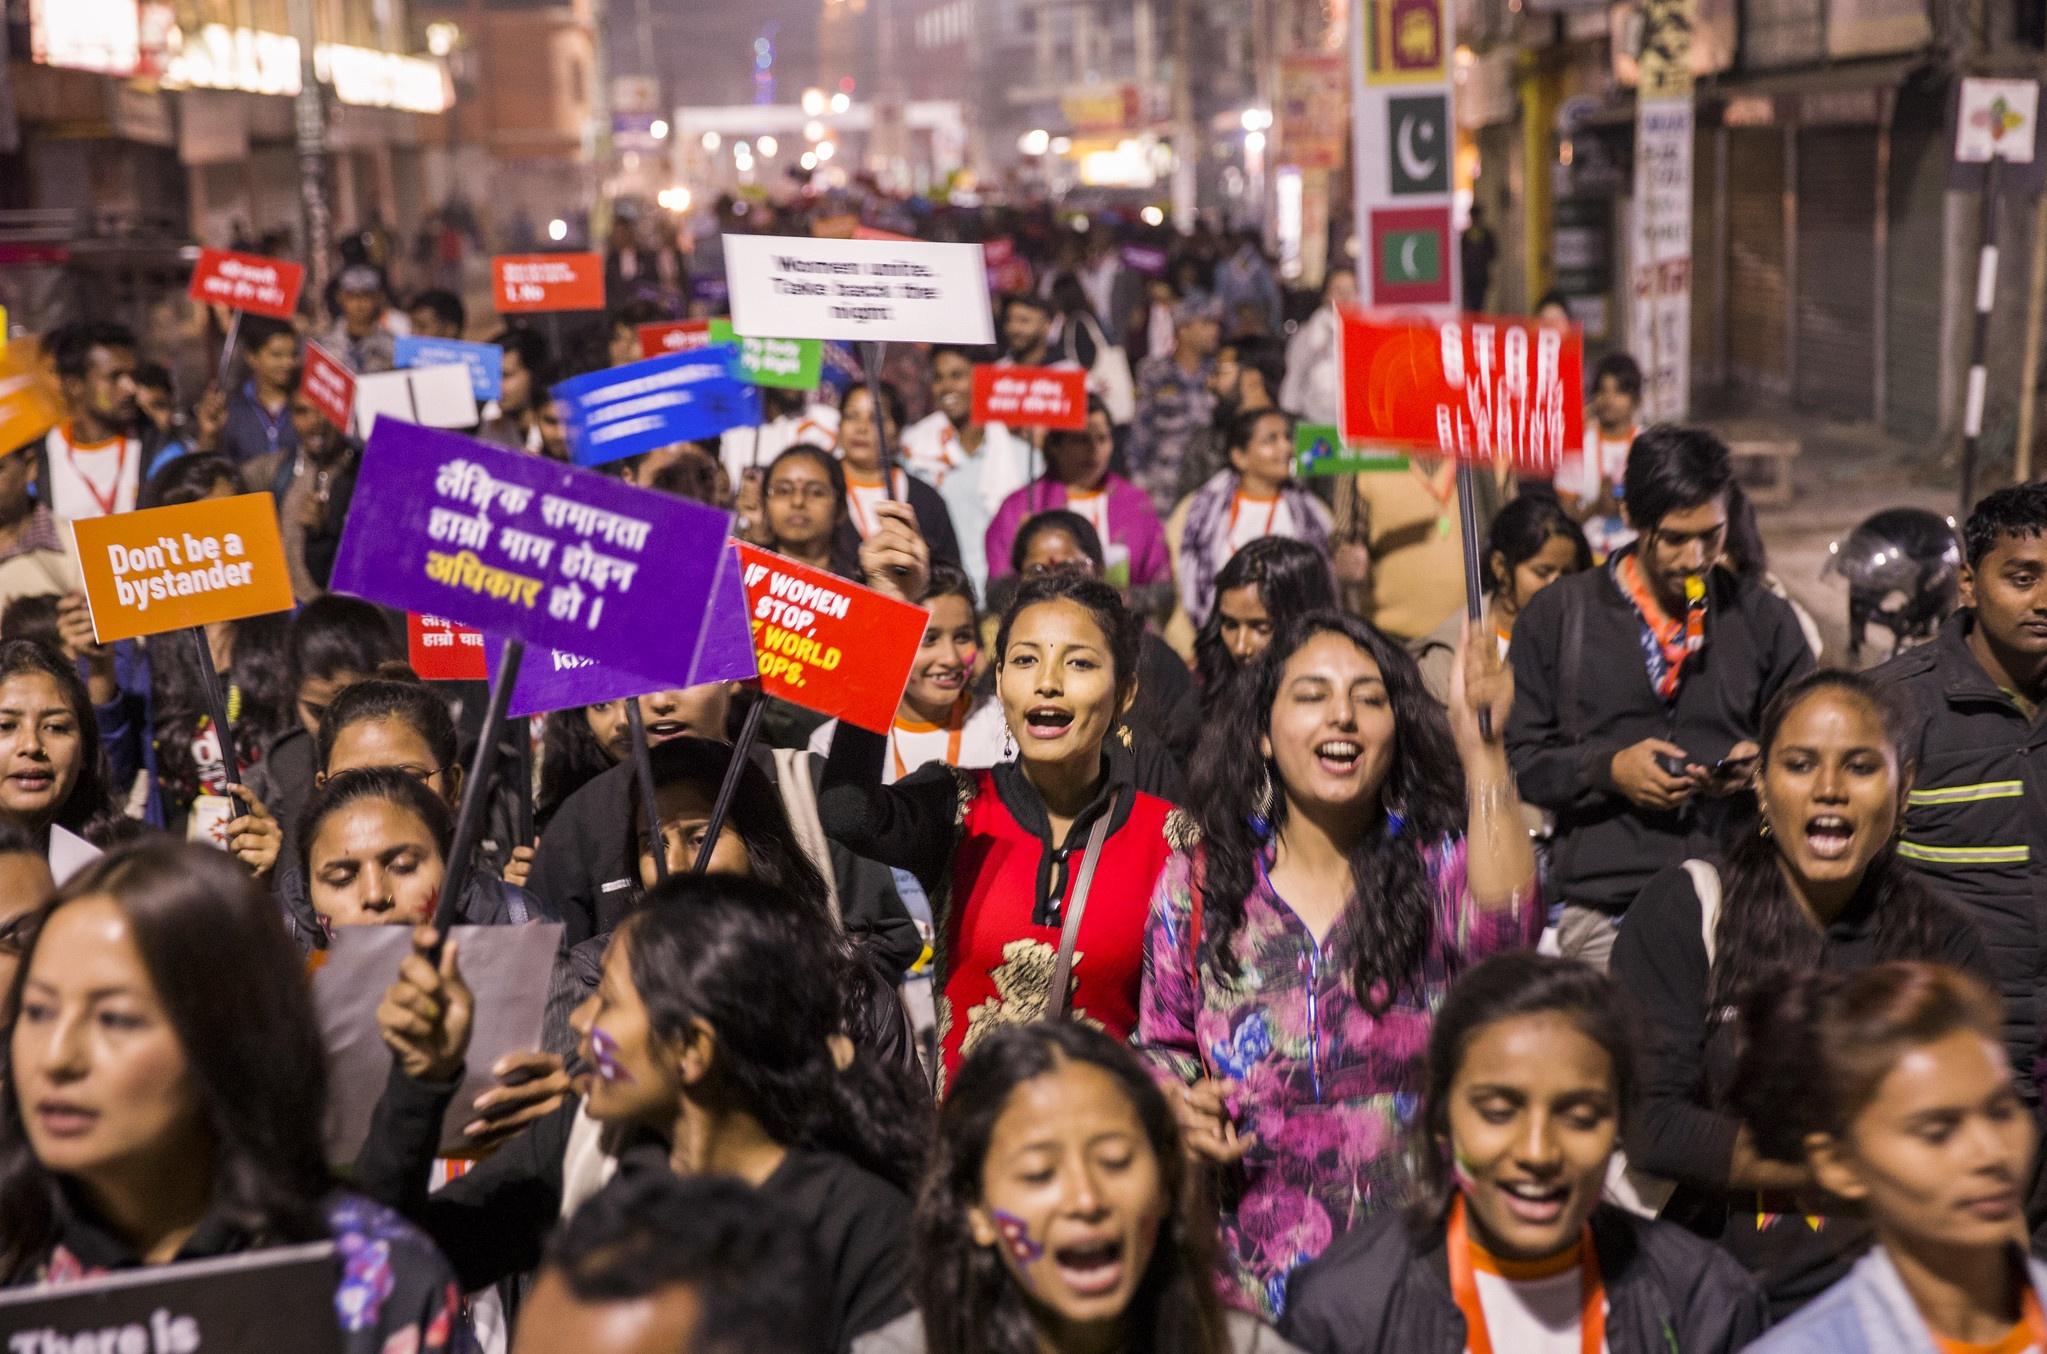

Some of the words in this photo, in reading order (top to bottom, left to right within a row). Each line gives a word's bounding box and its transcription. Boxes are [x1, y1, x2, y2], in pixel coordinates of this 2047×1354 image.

[769, 276, 828, 297] Take
[834, 281, 894, 299] back
[897, 284, 944, 300] the
[770, 255, 858, 277] Women
[1440, 320, 1562, 403] STOP
[540, 494, 652, 552] समानता
[107, 537, 182, 576] Don't
[182, 532, 221, 563] be
[223, 533, 244, 556] a
[499, 526, 556, 569] माग
[560, 540, 638, 593] होइन
[115, 559, 253, 611] bystander
[424, 549, 544, 609] अधिकार
[743, 562, 769, 588] IF
[769, 571, 852, 620] WOMEN
[754, 595, 817, 639] STOP,
[757, 650, 807, 688] OPS.
[763, 624, 842, 671] WORLD
